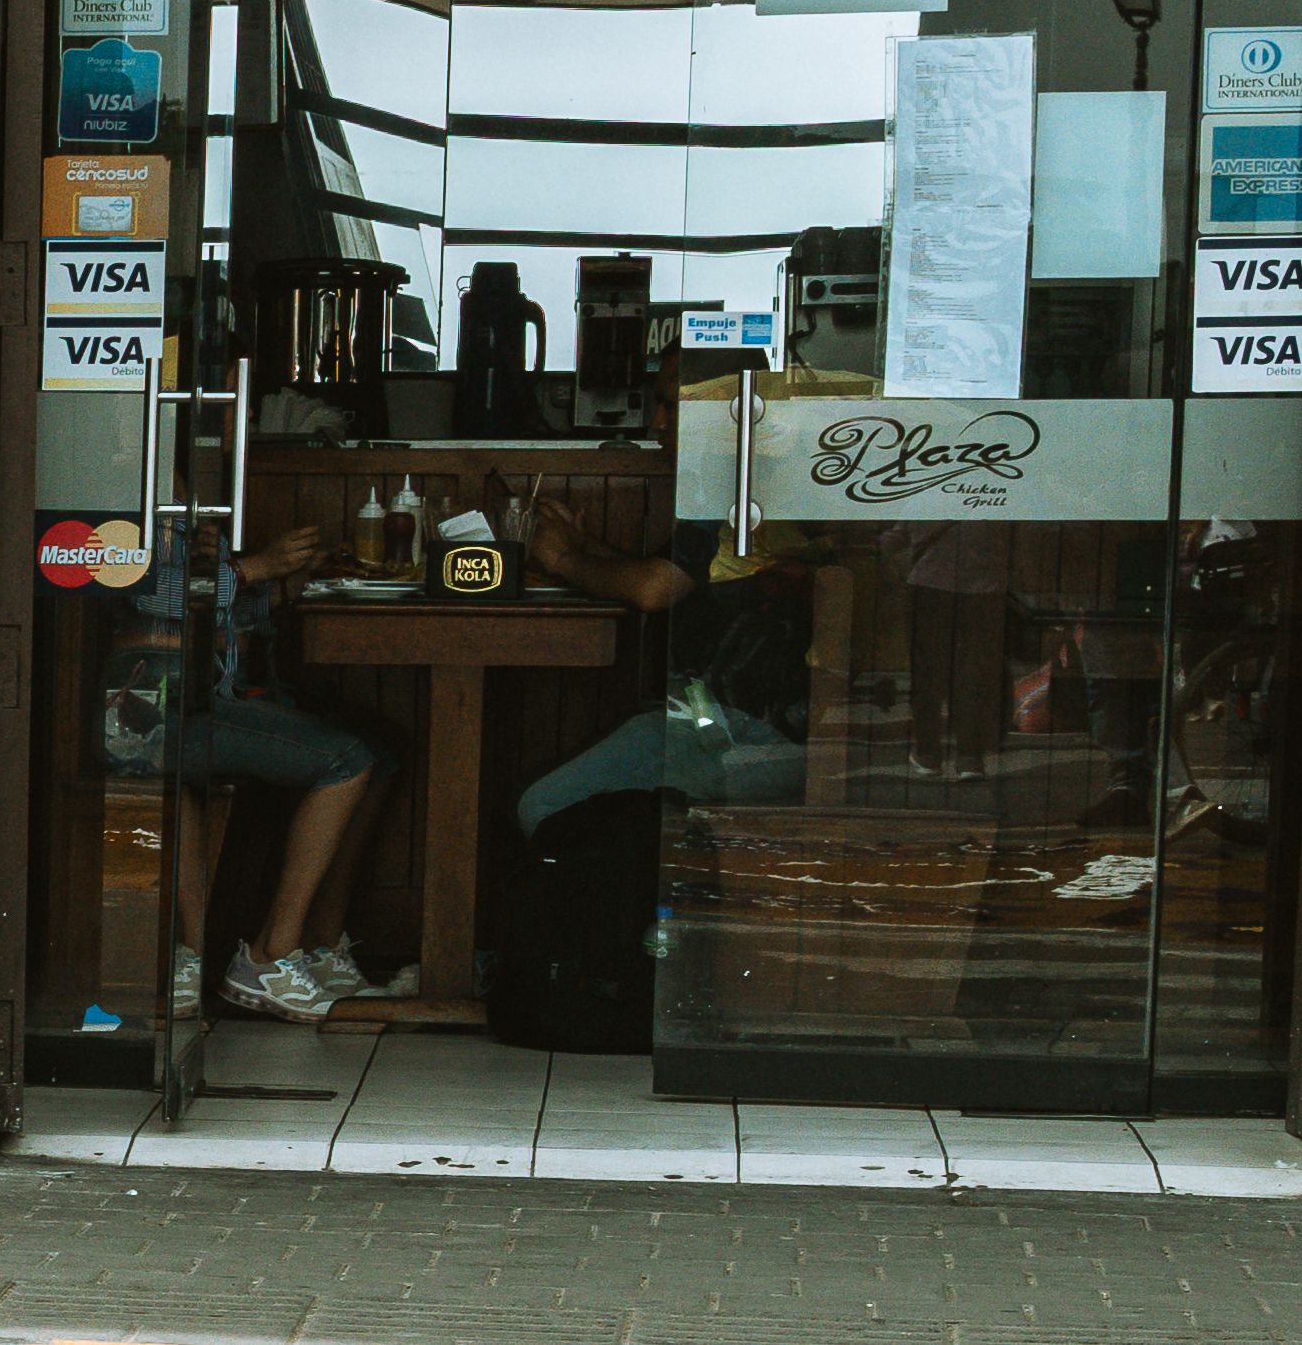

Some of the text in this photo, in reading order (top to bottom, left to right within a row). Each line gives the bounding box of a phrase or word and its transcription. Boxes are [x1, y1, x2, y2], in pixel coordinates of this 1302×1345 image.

[73, 14, 153, 23] INTERNATIONAL
[1218, 72, 1302, 89] Diners Club
[1218, 89, 1302, 99] INTERNATIONAL
[84, 93, 135, 112] VISA
[83, 118, 129, 131] niubiz
[66, 159, 100, 170] Tarjeta
[66, 165, 149, 181] cencosud
[59, 262, 151, 293] VISA
[687, 316, 737, 329] Empuje
[694, 331, 729, 343] Push
[58, 336, 145, 365] VISA
[1209, 335, 1302, 366] VISA
[111, 365, 145, 376] Débito
[1265, 366, 1302, 377] Débito
[810, 410, 1041, 504] Plaza
[941, 482, 1008, 495] Chicken
[962, 496, 1008, 510] Grill
[39, 544, 148, 565] MasterCard
[456, 558, 490, 569] INCA
[454, 569, 490, 582] KOLA
